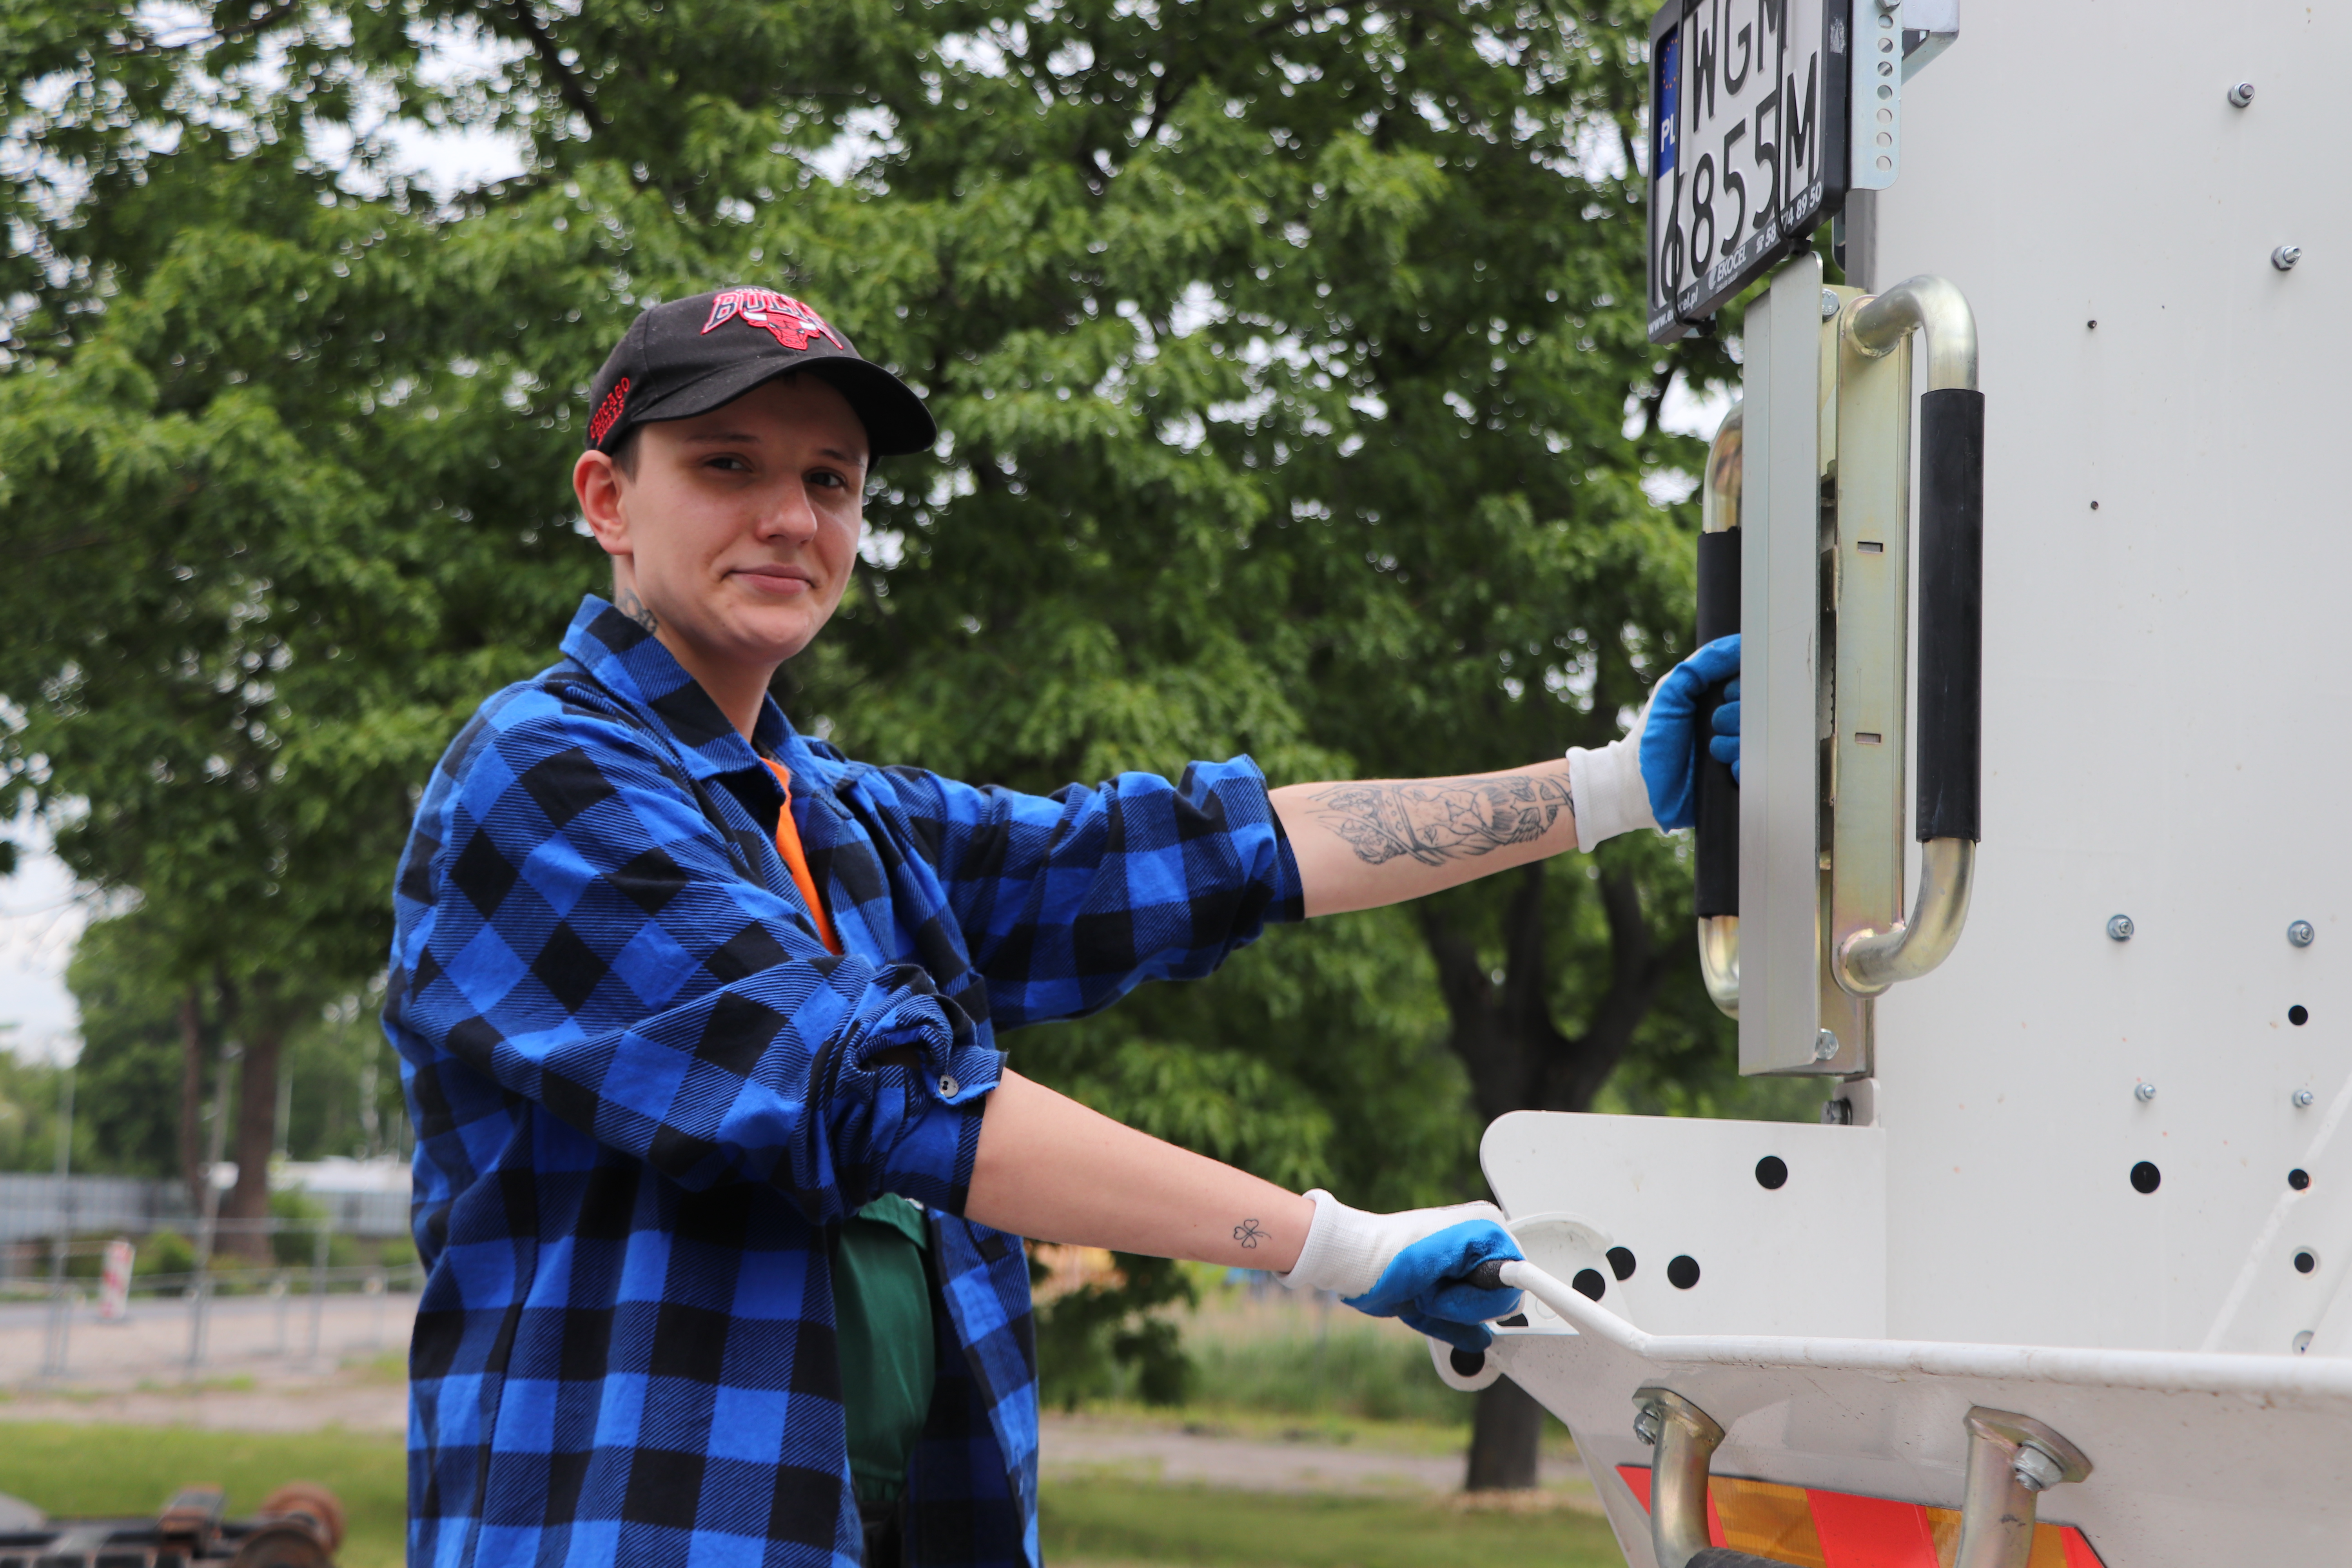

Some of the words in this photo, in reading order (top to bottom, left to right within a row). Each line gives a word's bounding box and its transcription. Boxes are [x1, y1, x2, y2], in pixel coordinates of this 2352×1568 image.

[1693, 0, 1788, 134] WGM
[1661, 113, 1676, 153] PL
[1661, 50, 1818, 302] 6855M
[1765, 222, 1776, 248] 58
[1781, 206, 1794, 232] 74
[1796, 194, 1808, 220] 89
[1809, 181, 1822, 208] 50
[1717, 245, 1747, 283] EKOCEL
[1648, 285, 1699, 335] www.ecel.pl
[590, 377, 630, 440] CHICAGO
[597, 397, 624, 446] BULLS
